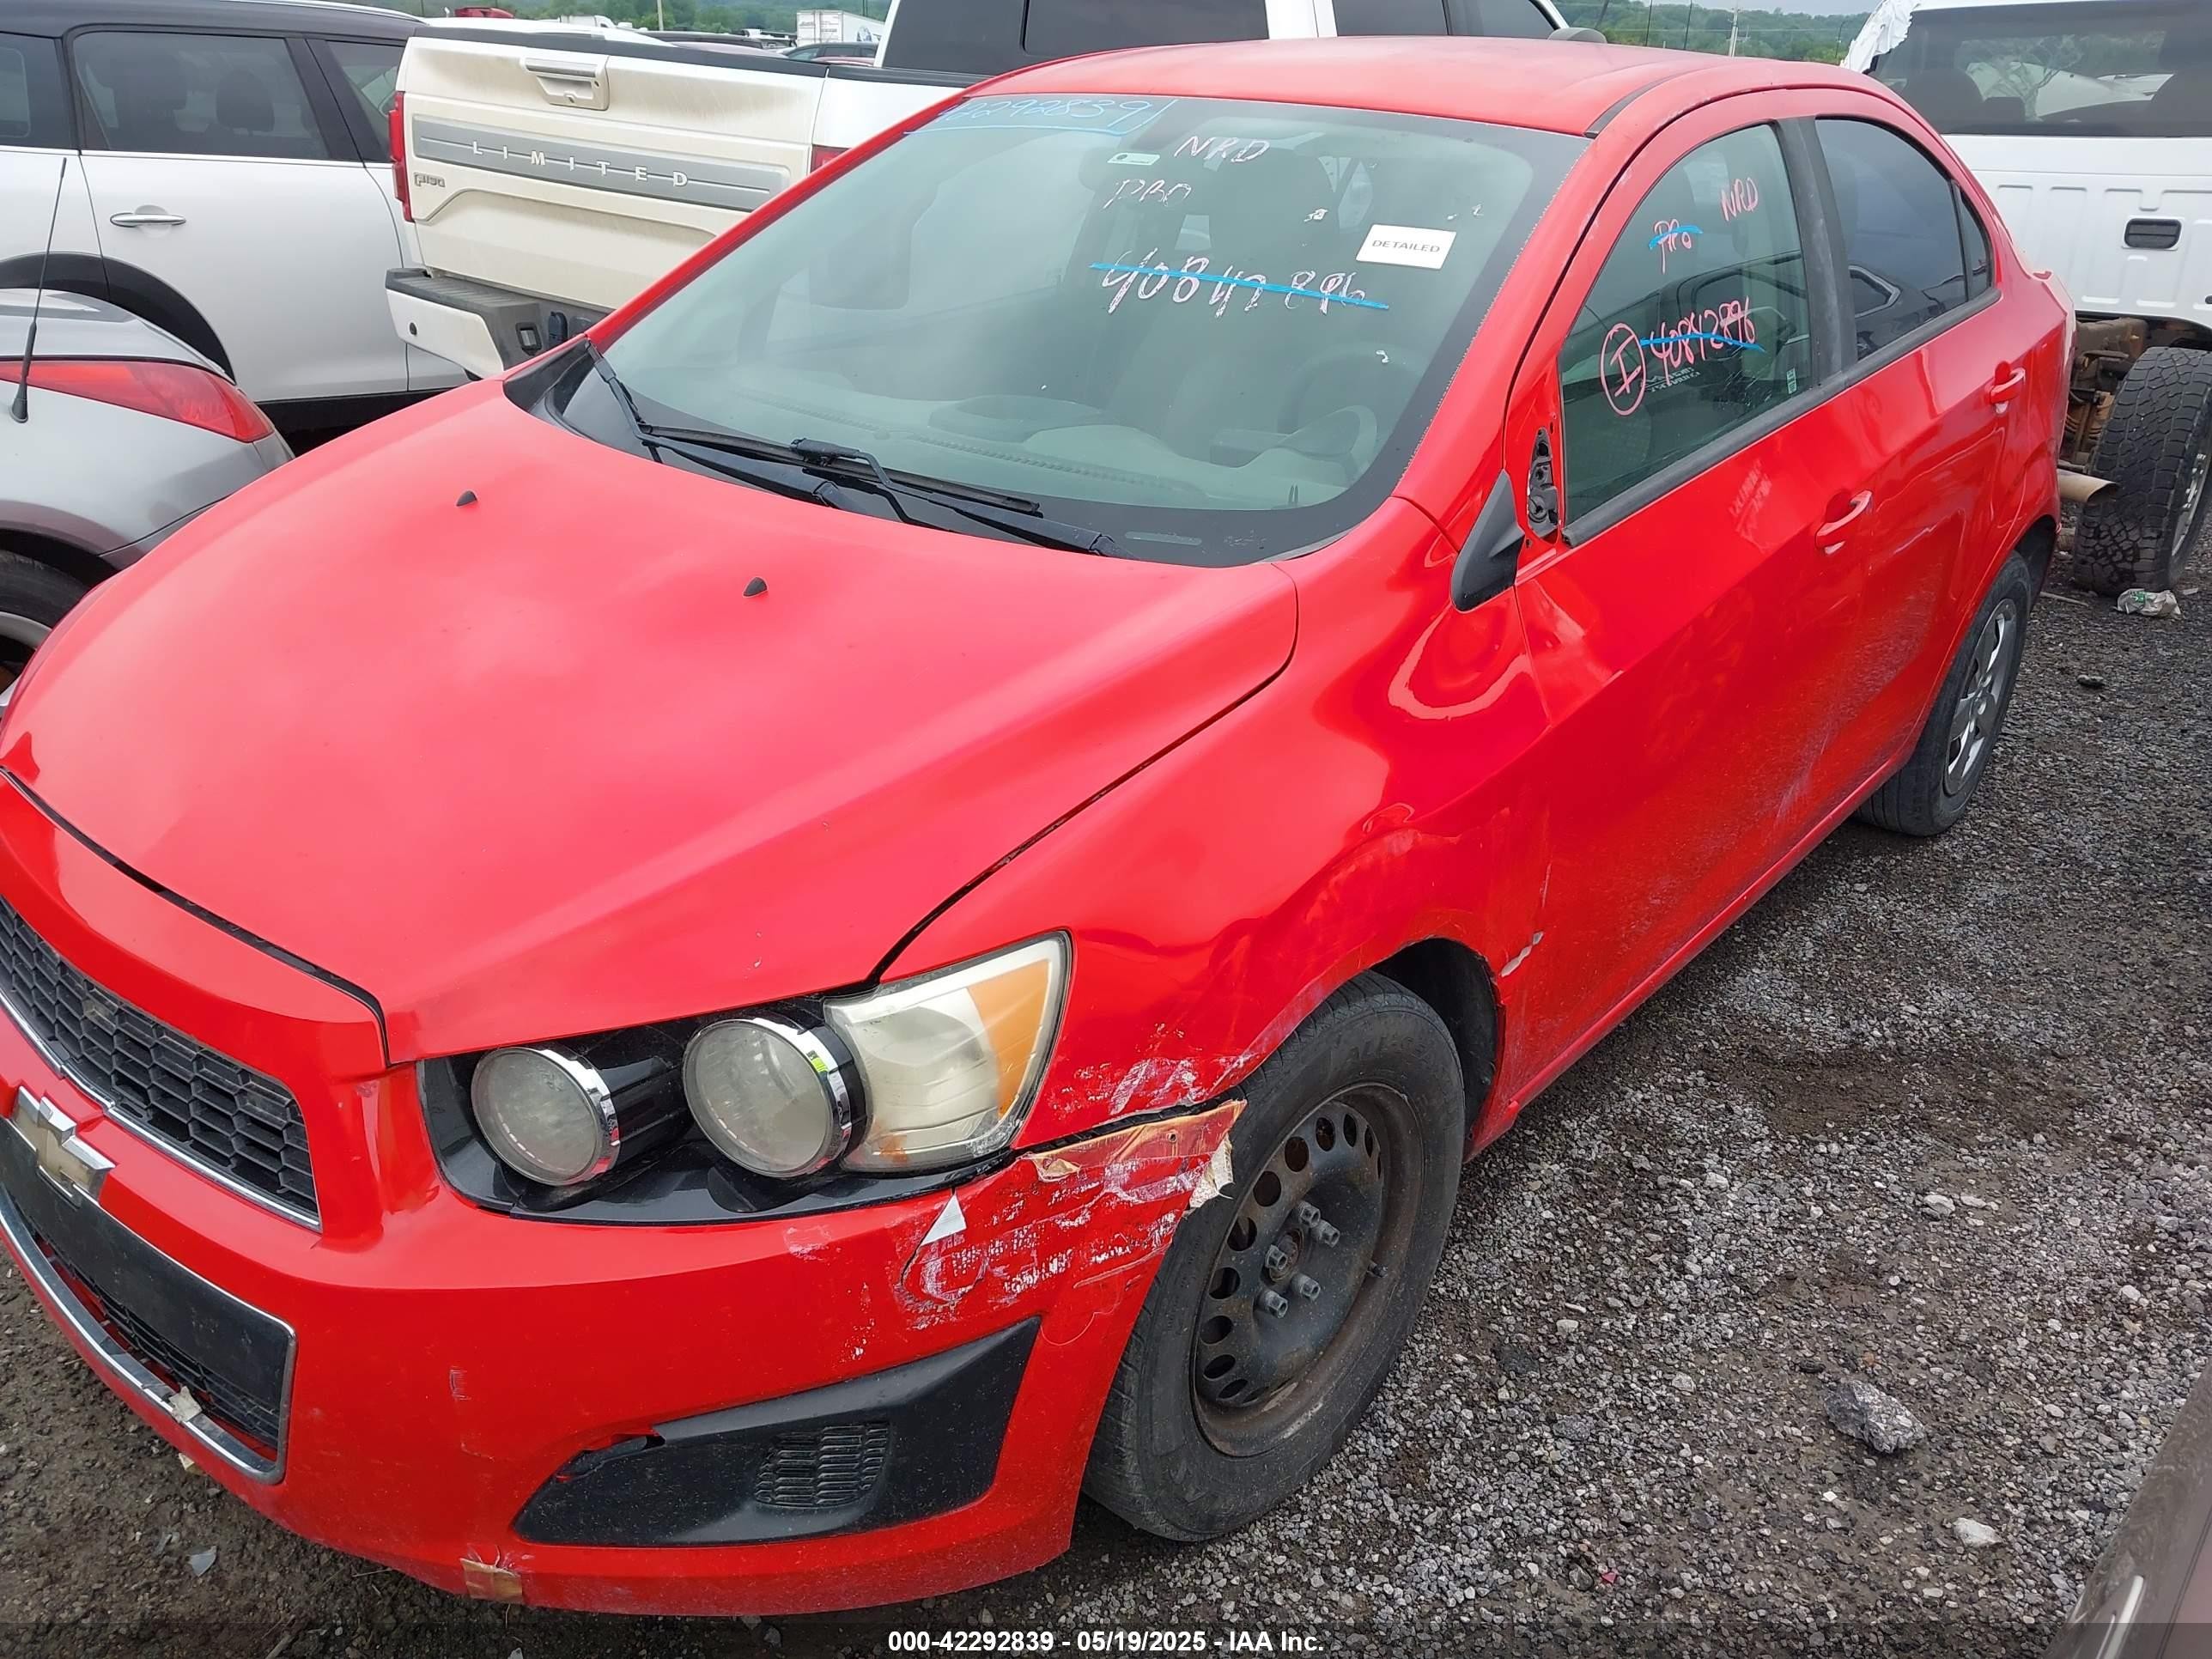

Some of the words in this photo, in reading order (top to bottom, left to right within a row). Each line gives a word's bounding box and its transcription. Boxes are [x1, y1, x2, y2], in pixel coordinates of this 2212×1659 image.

[472, 140, 689, 187] LIMITED
[1720, 177, 1759, 222] NRD
[1372, 240, 1441, 253] DETAILED
